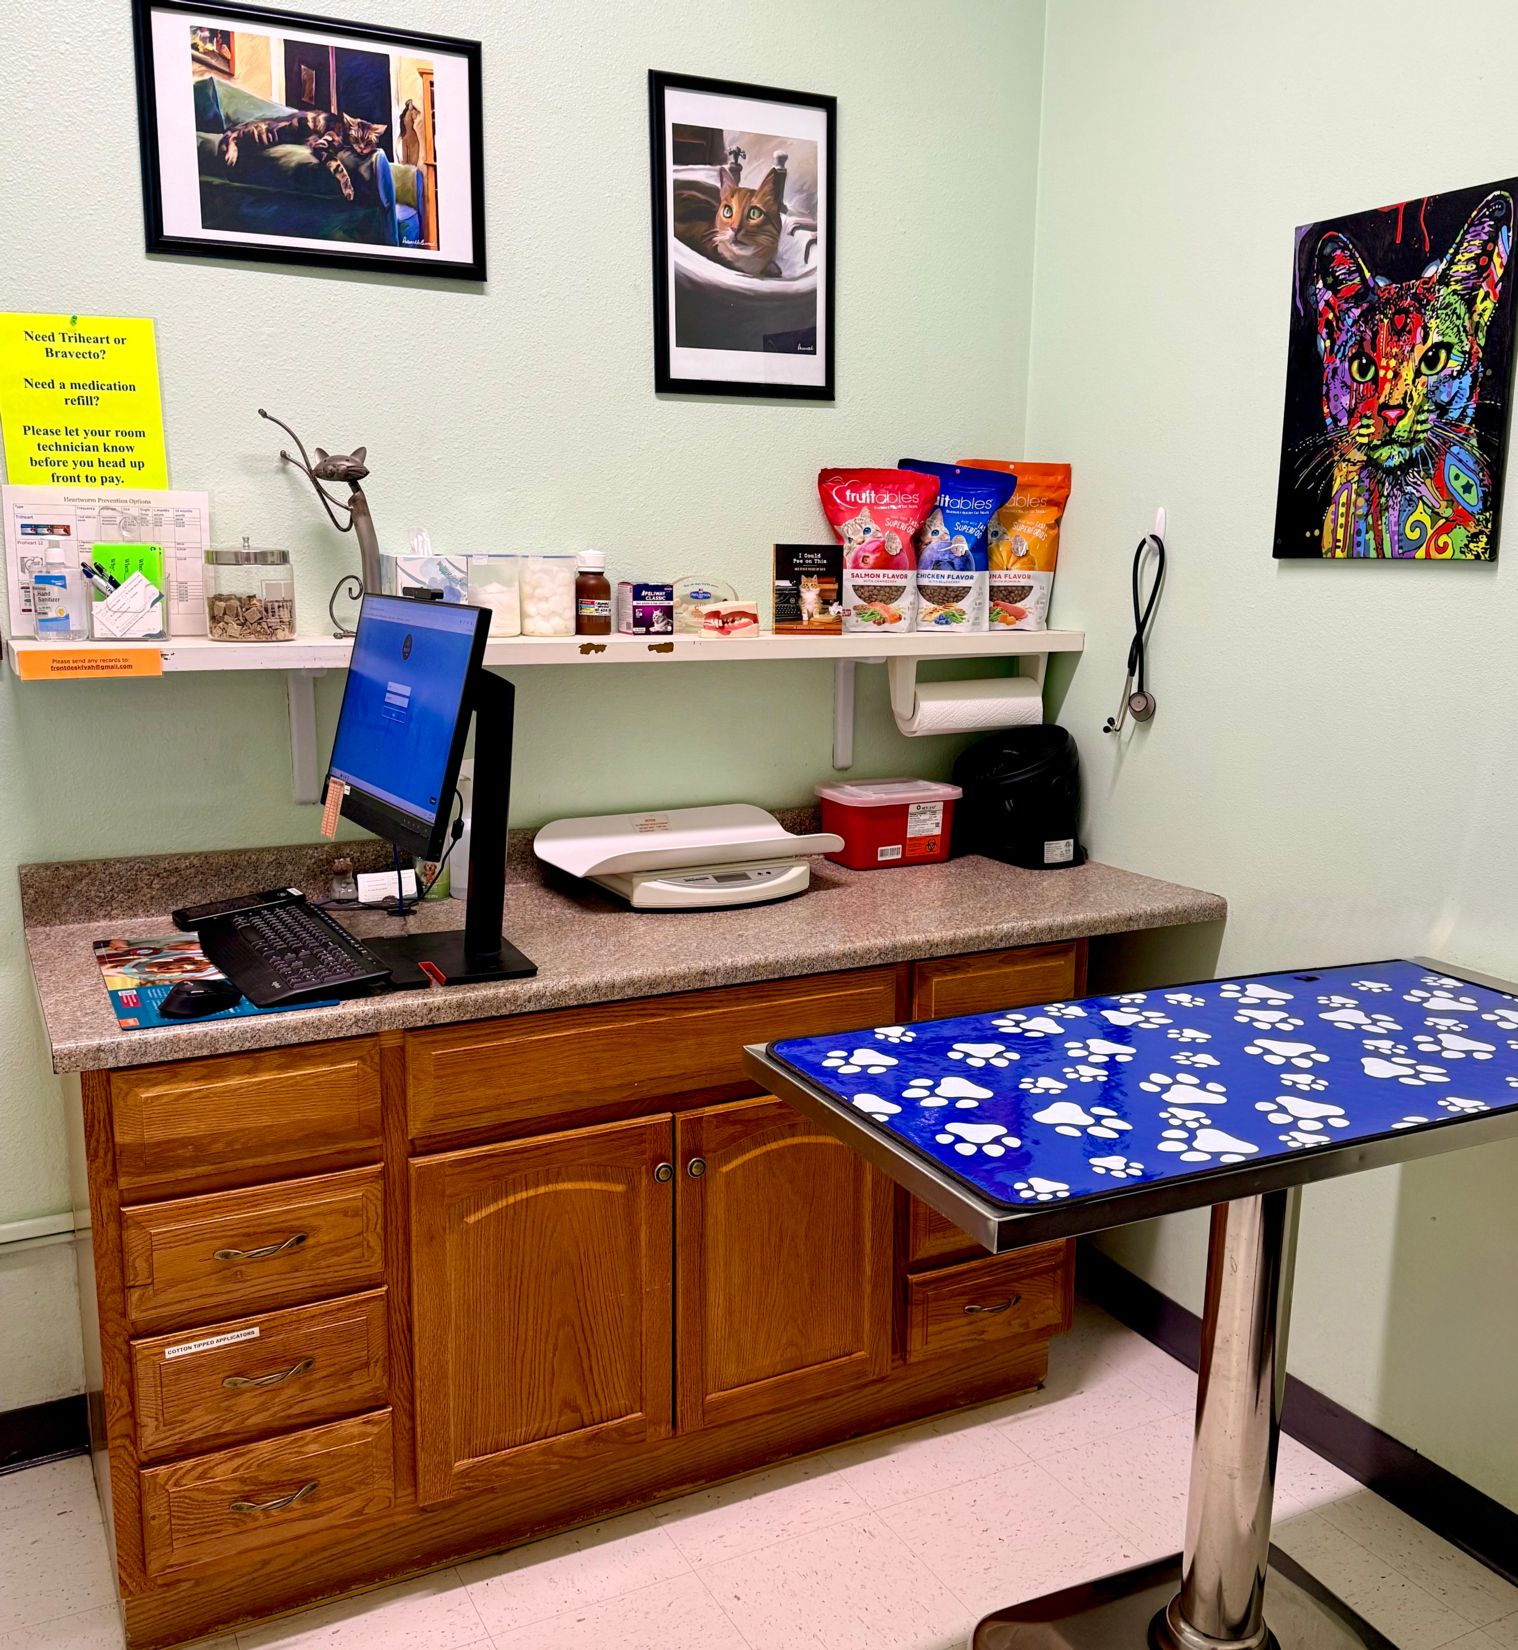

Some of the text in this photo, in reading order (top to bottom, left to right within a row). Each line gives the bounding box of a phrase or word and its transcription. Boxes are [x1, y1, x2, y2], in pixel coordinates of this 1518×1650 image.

[24, 331, 127, 345] Need Triheart or
[45, 347, 106, 360] Bravecto?
[24, 378, 136, 392] Need a medication
[64, 395, 100, 406] refill?
[23, 425, 146, 439] Please let your room
[37, 442, 135, 453] technician know
[30, 457, 145, 471] before you head up
[51, 472, 124, 486] front to pay.
[845, 489, 920, 504] fruitables
[167, 1330, 255, 1355] COTTON TIPPED APPLICATORS
